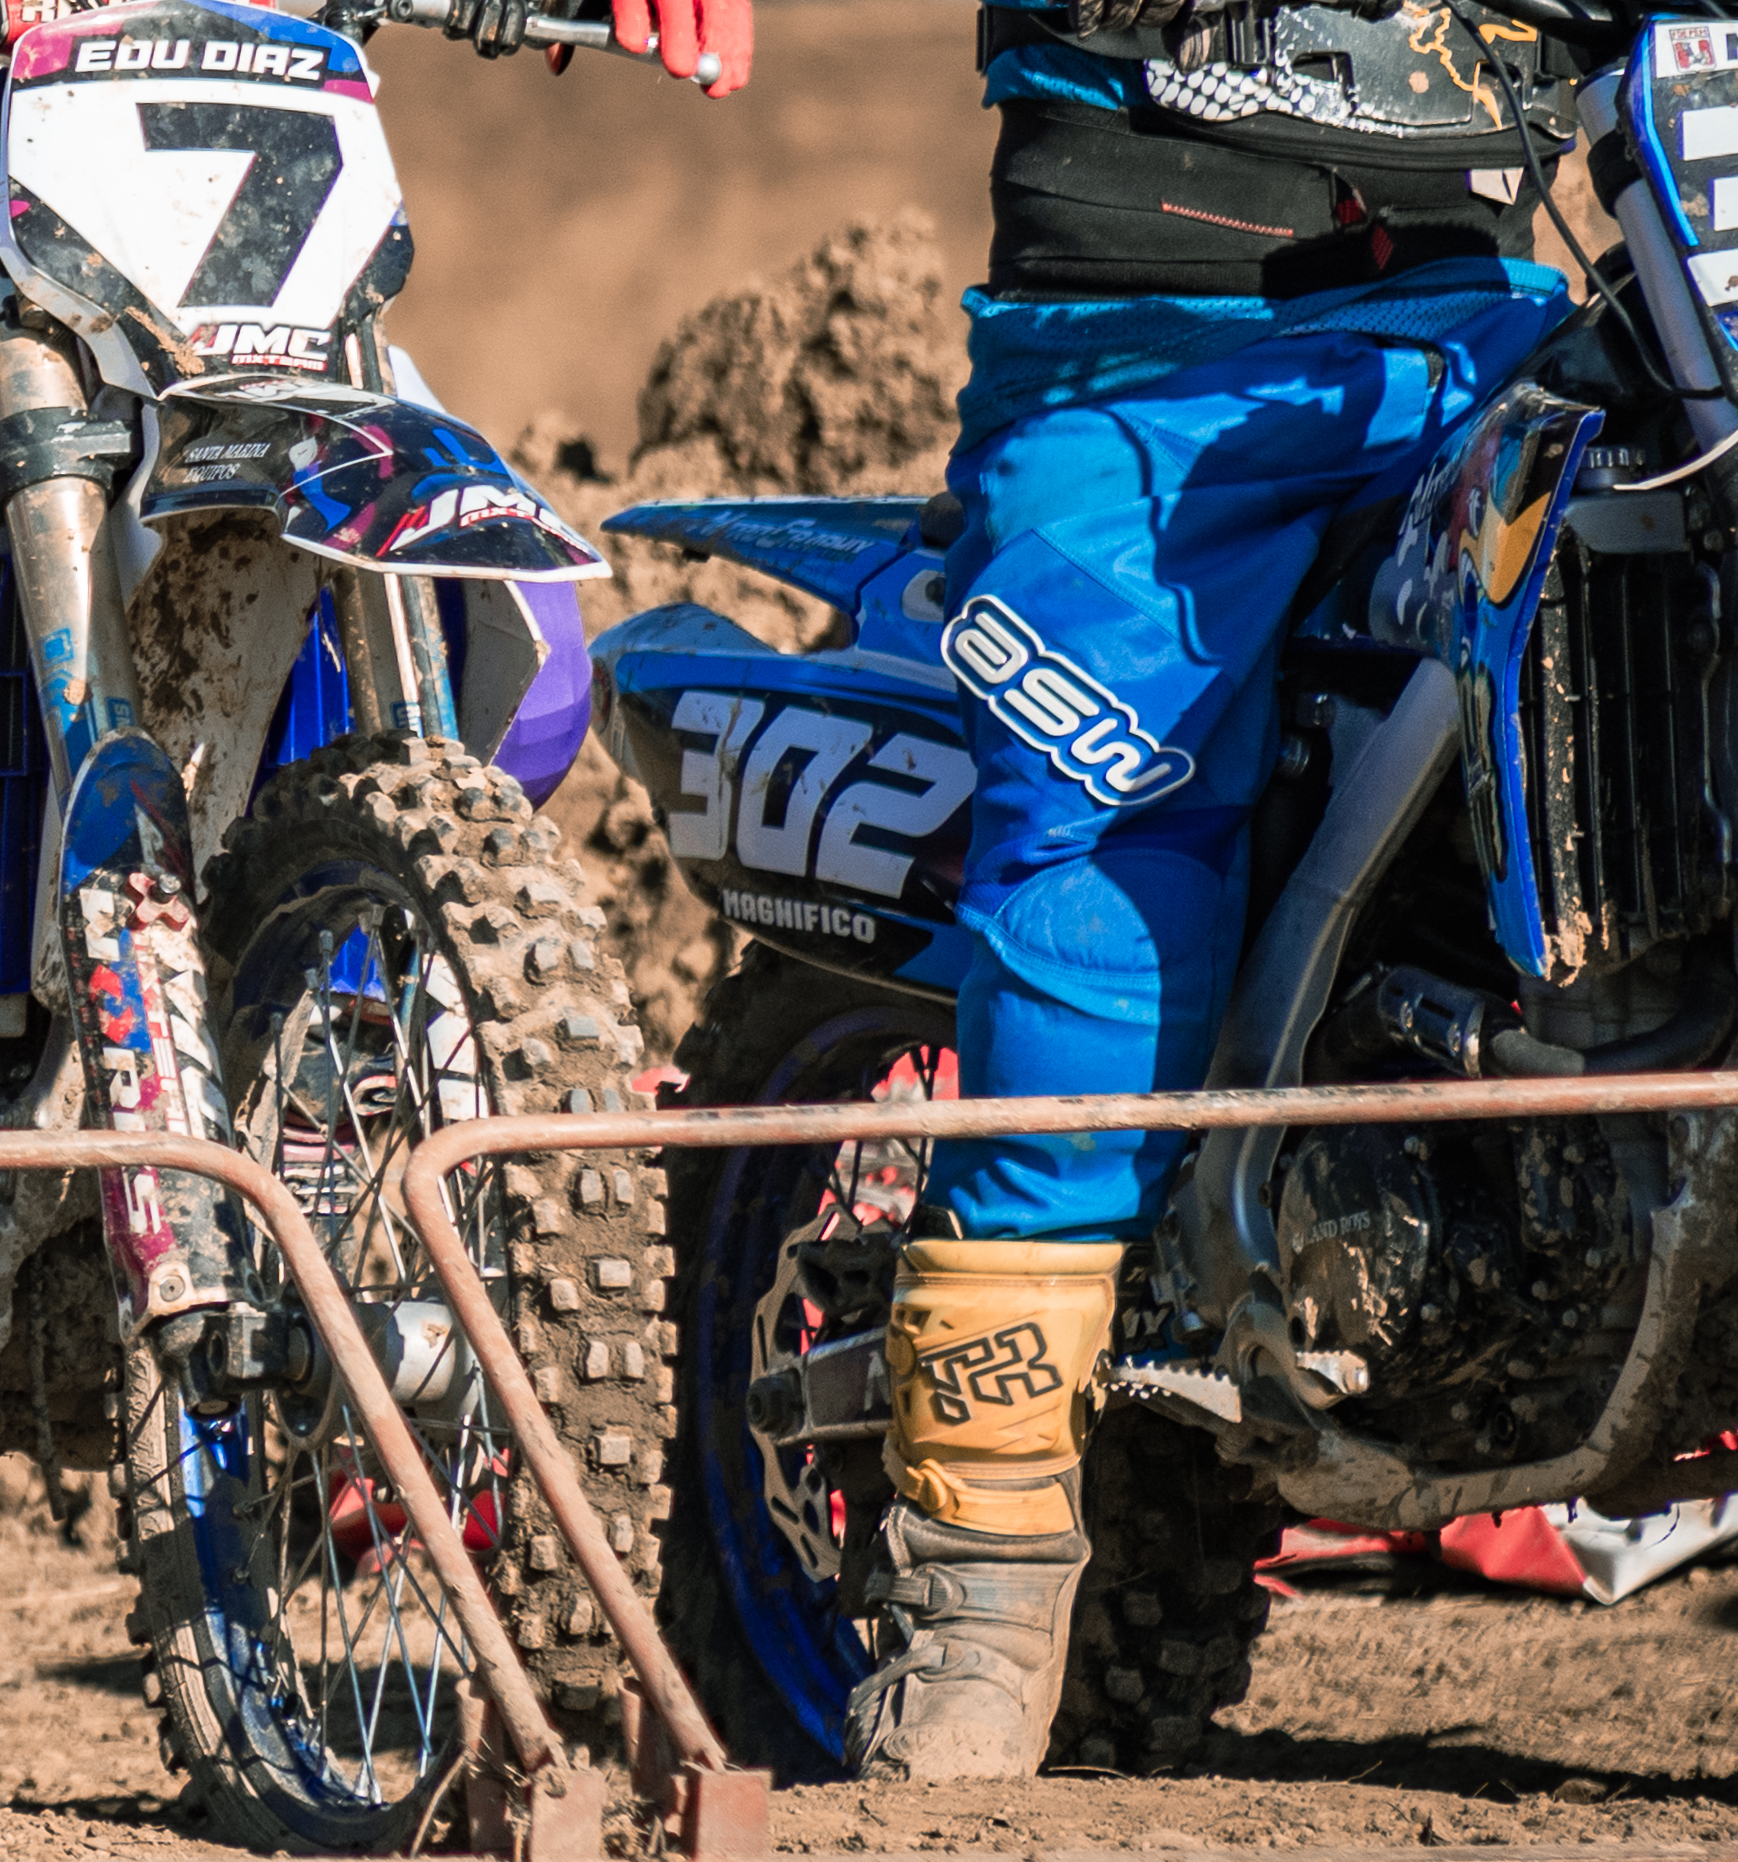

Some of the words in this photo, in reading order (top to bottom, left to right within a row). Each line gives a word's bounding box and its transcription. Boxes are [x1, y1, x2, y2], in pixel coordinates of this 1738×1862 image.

[75, 40, 190, 74] EDU
[200, 43, 325, 81] DIAZ
[136, 102, 343, 308] 7
[194, 323, 332, 362] JMC
[670, 691, 978, 900] 302
[722, 889, 877, 944] MAGNIFICO
